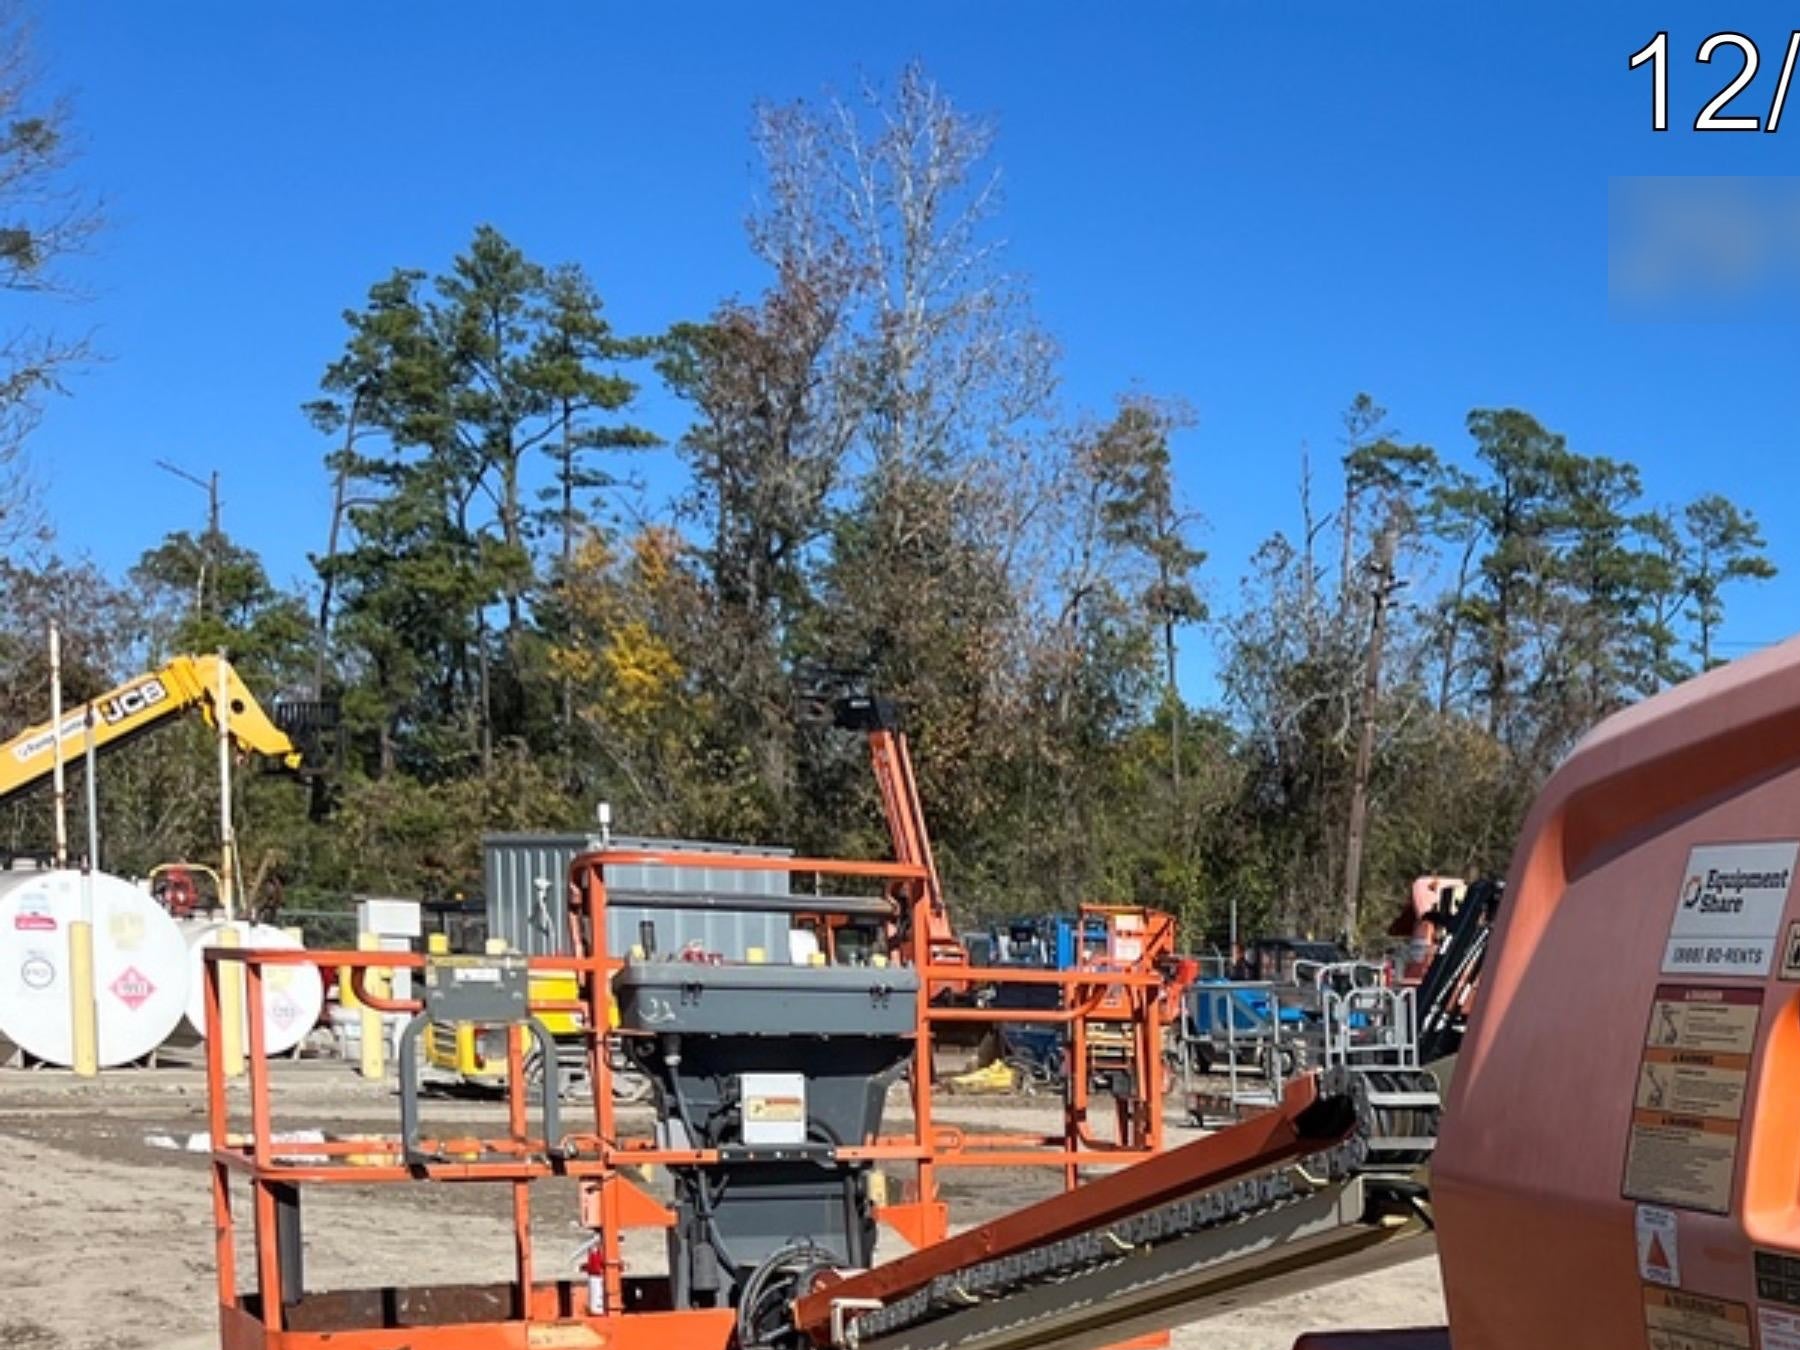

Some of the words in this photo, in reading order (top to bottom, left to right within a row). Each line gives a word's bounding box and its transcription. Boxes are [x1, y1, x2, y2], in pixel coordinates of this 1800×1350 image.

[102, 679, 167, 724] JCB
[1707, 868, 1789, 892] Equipment
[1699, 894, 1744, 912] Share
